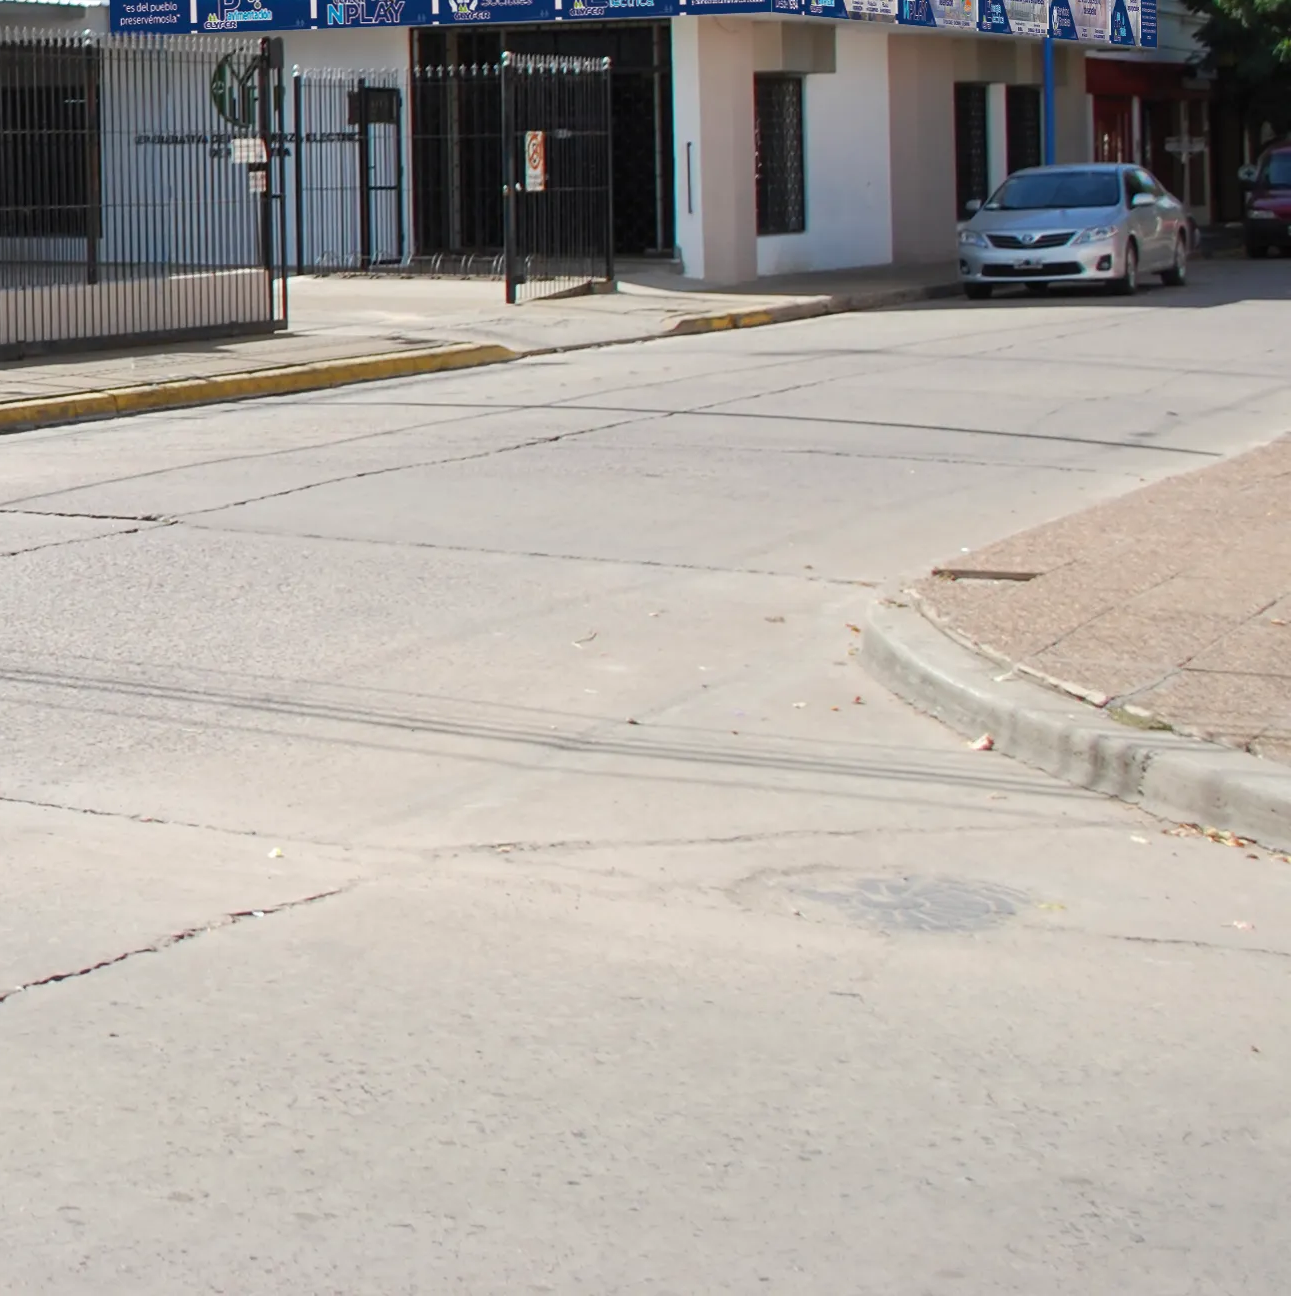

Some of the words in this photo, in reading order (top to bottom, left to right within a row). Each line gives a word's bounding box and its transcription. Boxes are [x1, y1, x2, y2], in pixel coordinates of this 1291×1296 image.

[136, 2, 149, 12] del
[150, 1, 178, 13] pueblo
[204, 21, 237, 29] CLYFER
